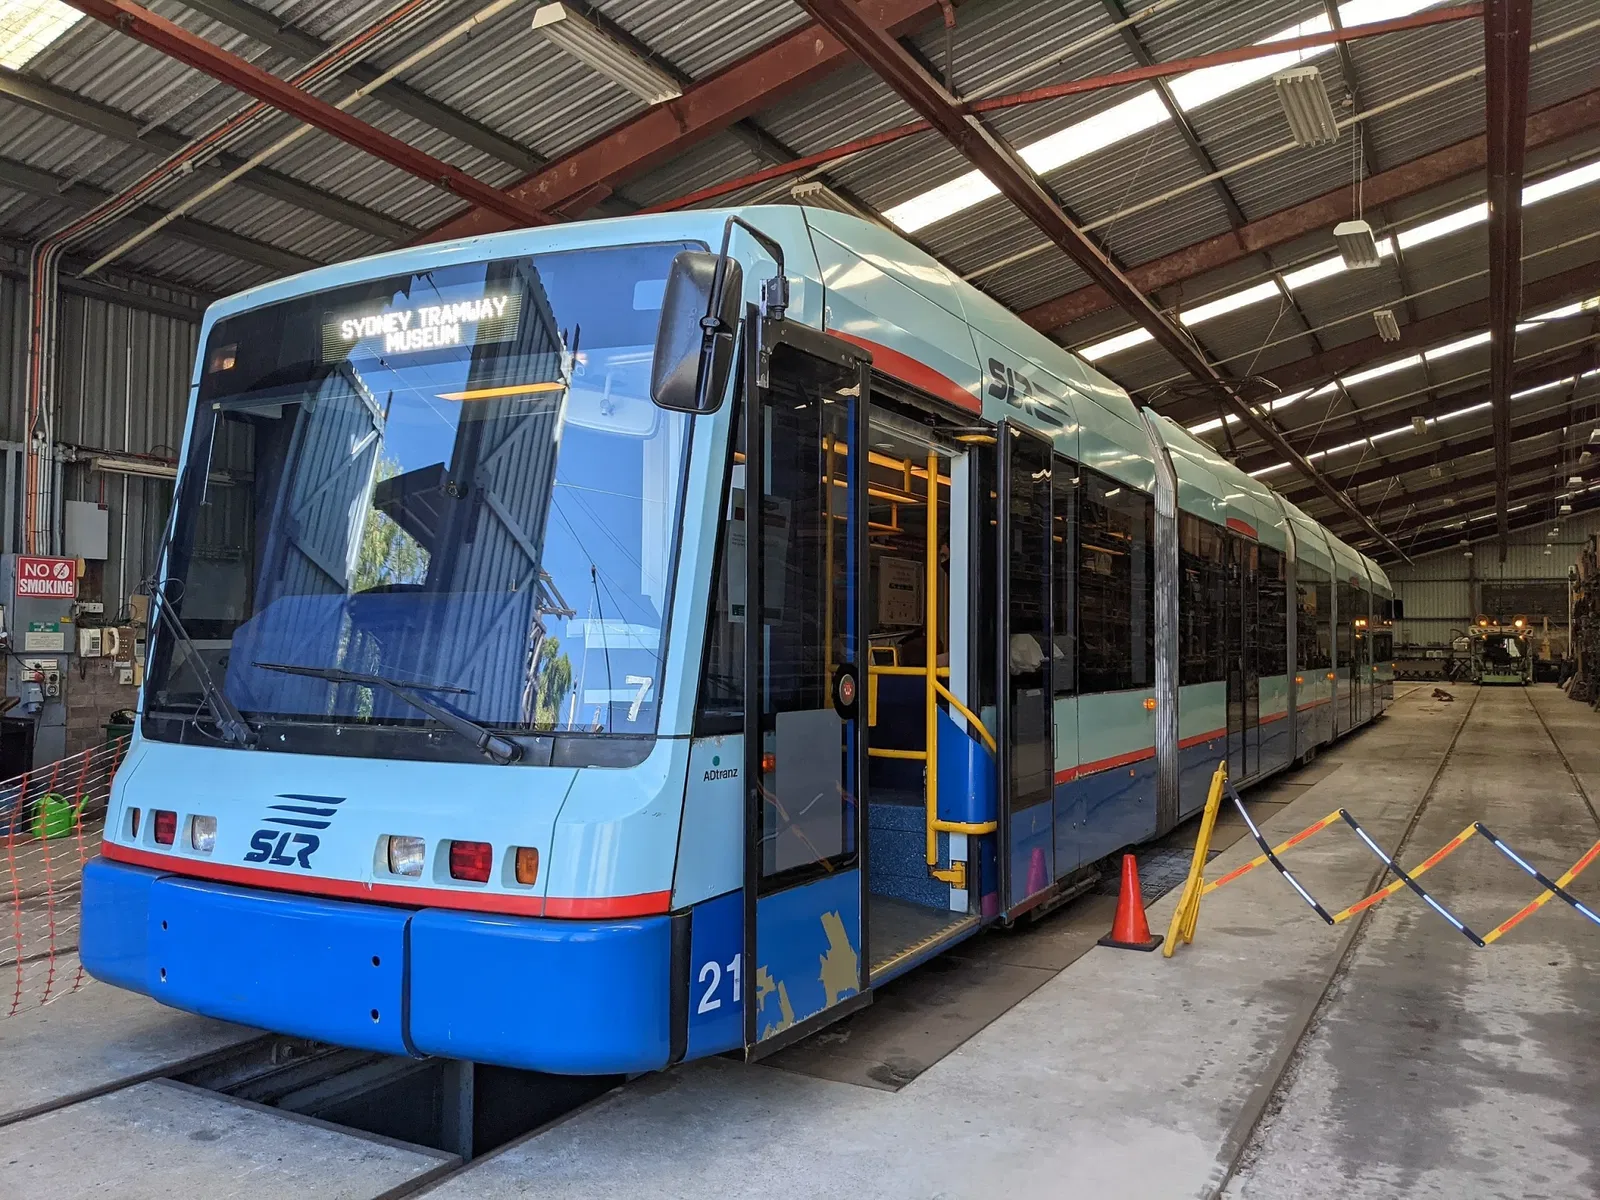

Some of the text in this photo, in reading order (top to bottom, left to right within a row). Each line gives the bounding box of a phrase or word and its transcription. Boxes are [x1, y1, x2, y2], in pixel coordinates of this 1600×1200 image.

[341, 295, 508, 340] SYDNEY TRAMWAY
[386, 324, 460, 353] MUSEUM
[25, 563, 50, 577] NO
[20, 579, 73, 594] SMOKING
[626, 675, 653, 721] 7
[703, 768, 738, 782] ADtranz
[243, 829, 320, 869] SLR
